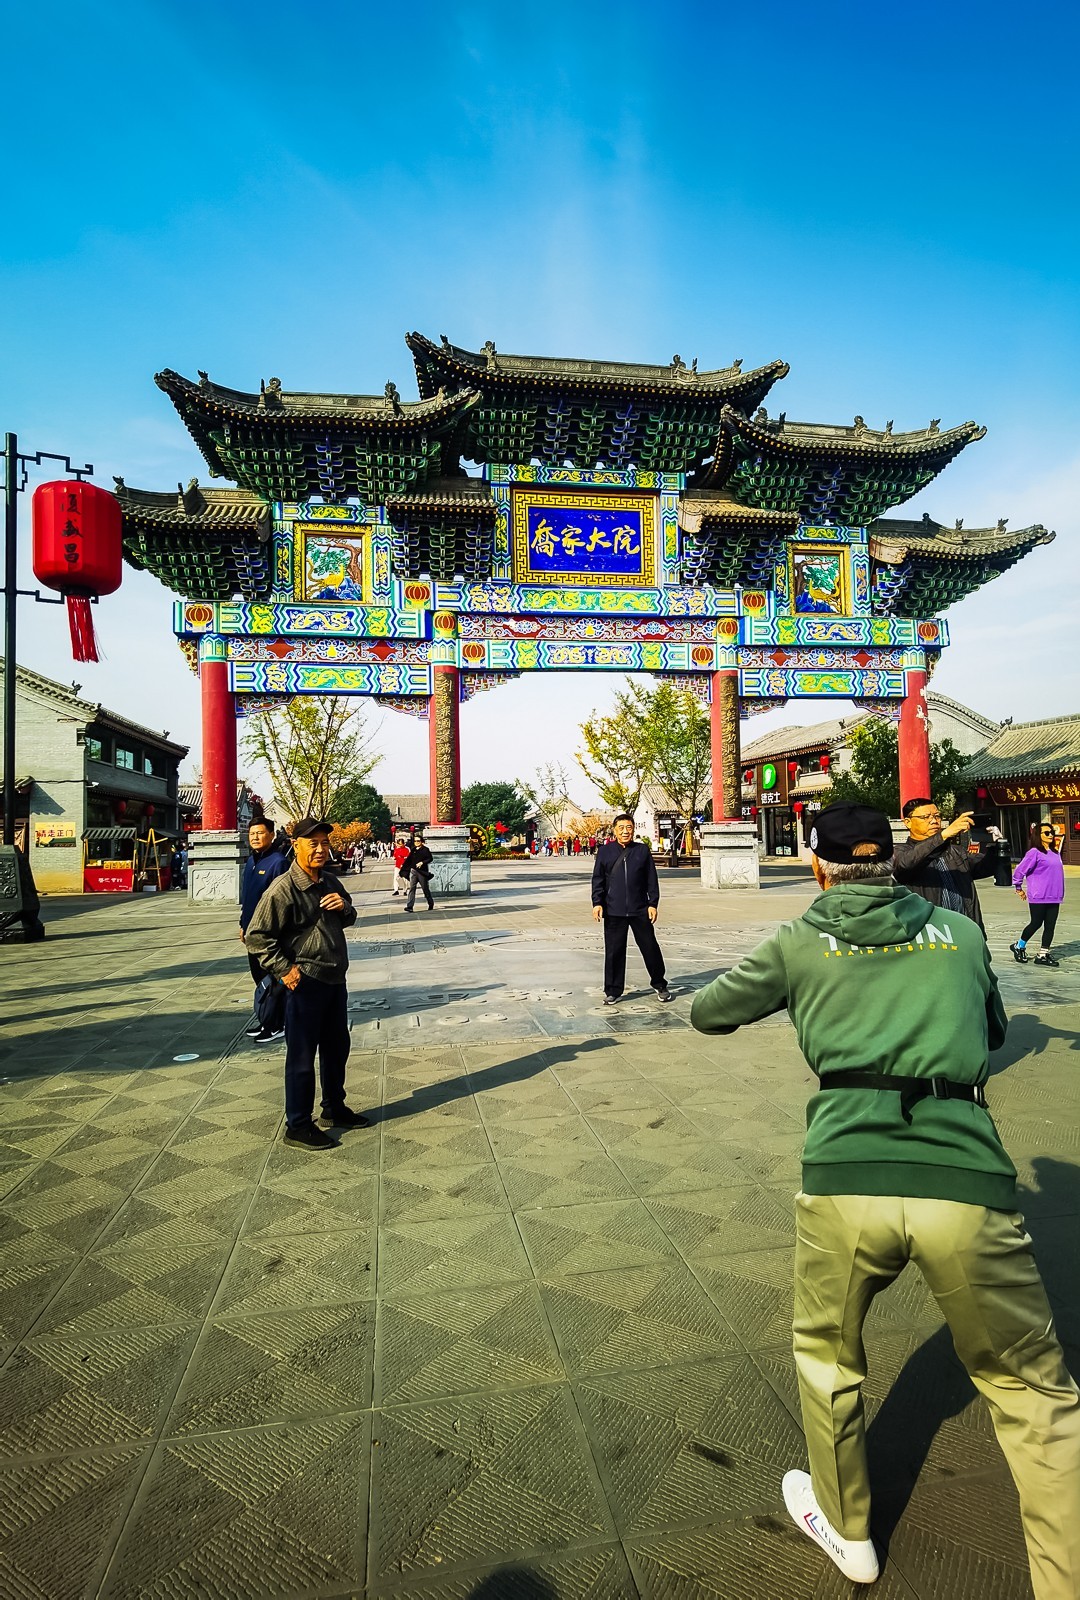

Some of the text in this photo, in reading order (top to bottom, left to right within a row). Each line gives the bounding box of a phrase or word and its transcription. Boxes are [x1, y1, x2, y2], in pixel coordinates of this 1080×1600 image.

[531, 518, 640, 557] 喬家大院
[760, 791, 781, 804] 德克士
[819, 923, 954, 951] TIN
[823, 949, 874, 958] TRAIN
